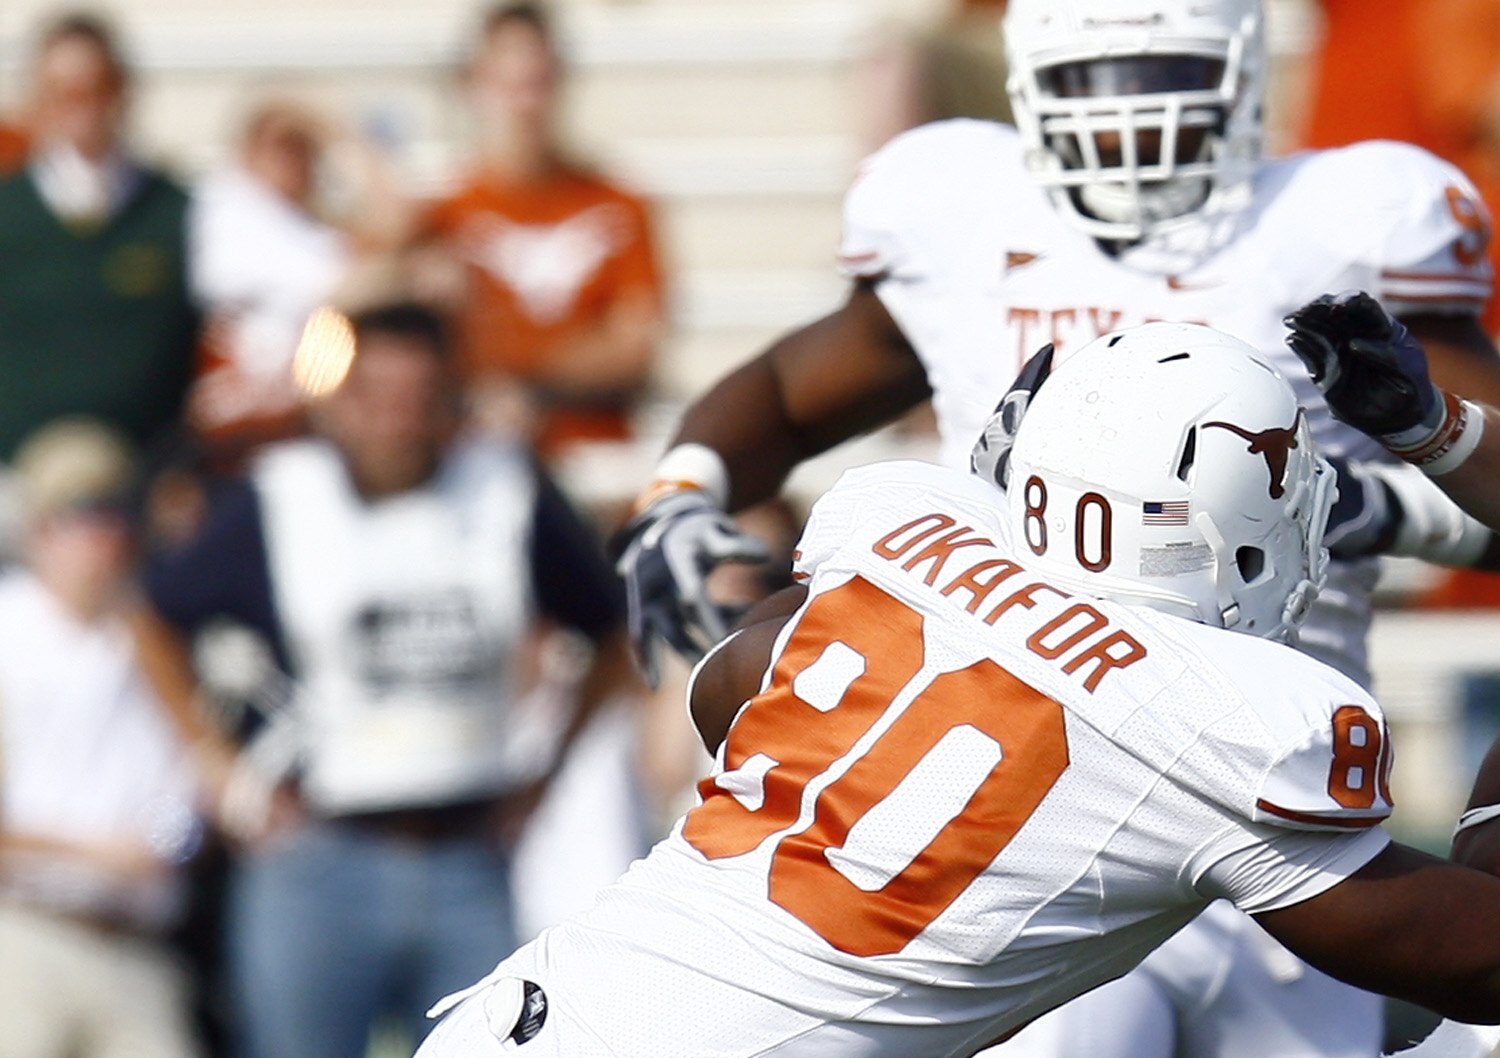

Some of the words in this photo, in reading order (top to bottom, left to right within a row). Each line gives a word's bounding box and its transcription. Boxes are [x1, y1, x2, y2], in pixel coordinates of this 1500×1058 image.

[871, 513, 1147, 694] OKAFOR
[1024, 475, 1112, 572] 80
[680, 574, 1070, 957] 80
